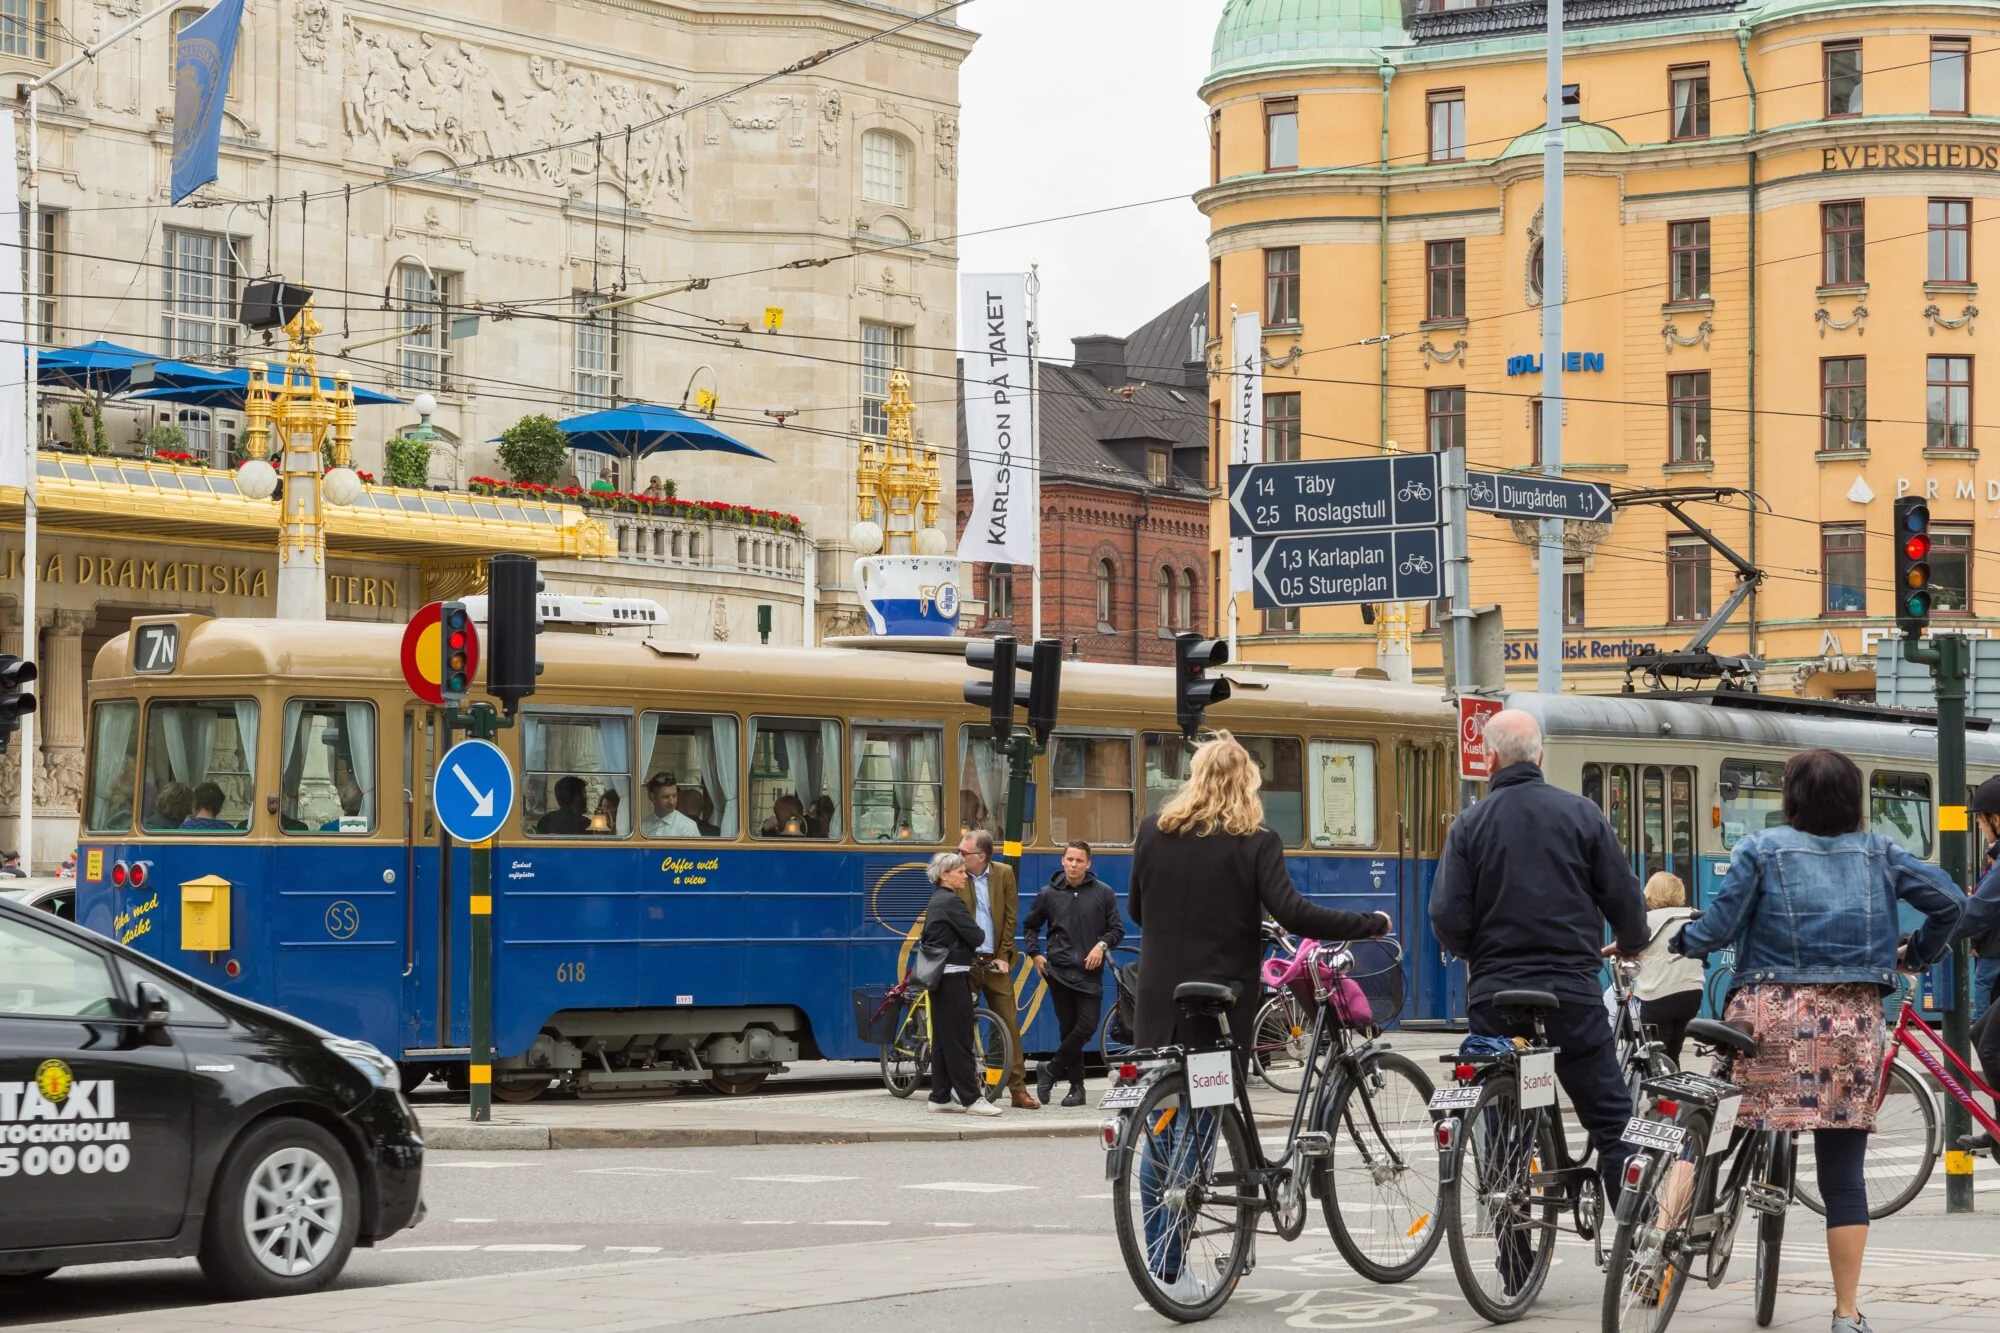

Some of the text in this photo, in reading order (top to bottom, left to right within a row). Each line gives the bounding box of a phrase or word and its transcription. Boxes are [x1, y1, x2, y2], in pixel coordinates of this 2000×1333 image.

[1820, 143, 2000, 172] EVERSHEDS
[986, 291, 1011, 545] KARLSSON PÅ TAKET
[1255, 475, 1336, 497] 14 Täby
[1503, 486, 1593, 512] Djurgården 1,1
[1256, 500, 1386, 526] 2,5 Roslagstull
[1280, 546, 1385, 571] 1,3 Karlaplan
[78, 555, 269, 598] DRAMATISKA
[1280, 573, 1387, 598] 0,5 Stureplan
[146, 629, 175, 669] 7N
[661, 856, 719, 873] Coffee with
[673, 875, 706, 885] a view
[133, 892, 159, 918] med
[330, 906, 356, 933] SS
[556, 962, 586, 983] 618
[1192, 1071, 1229, 1089] Scandic
[1523, 1072, 1552, 1090] Scandic
[0, 1079, 115, 1121] TAXI
[1433, 1090, 1454, 1100] BE
[0, 1121, 131, 1144] TOCKHOLM
[1628, 1120, 1682, 1140] BE 170
[1630, 1134, 1671, 1149] KRONAN
